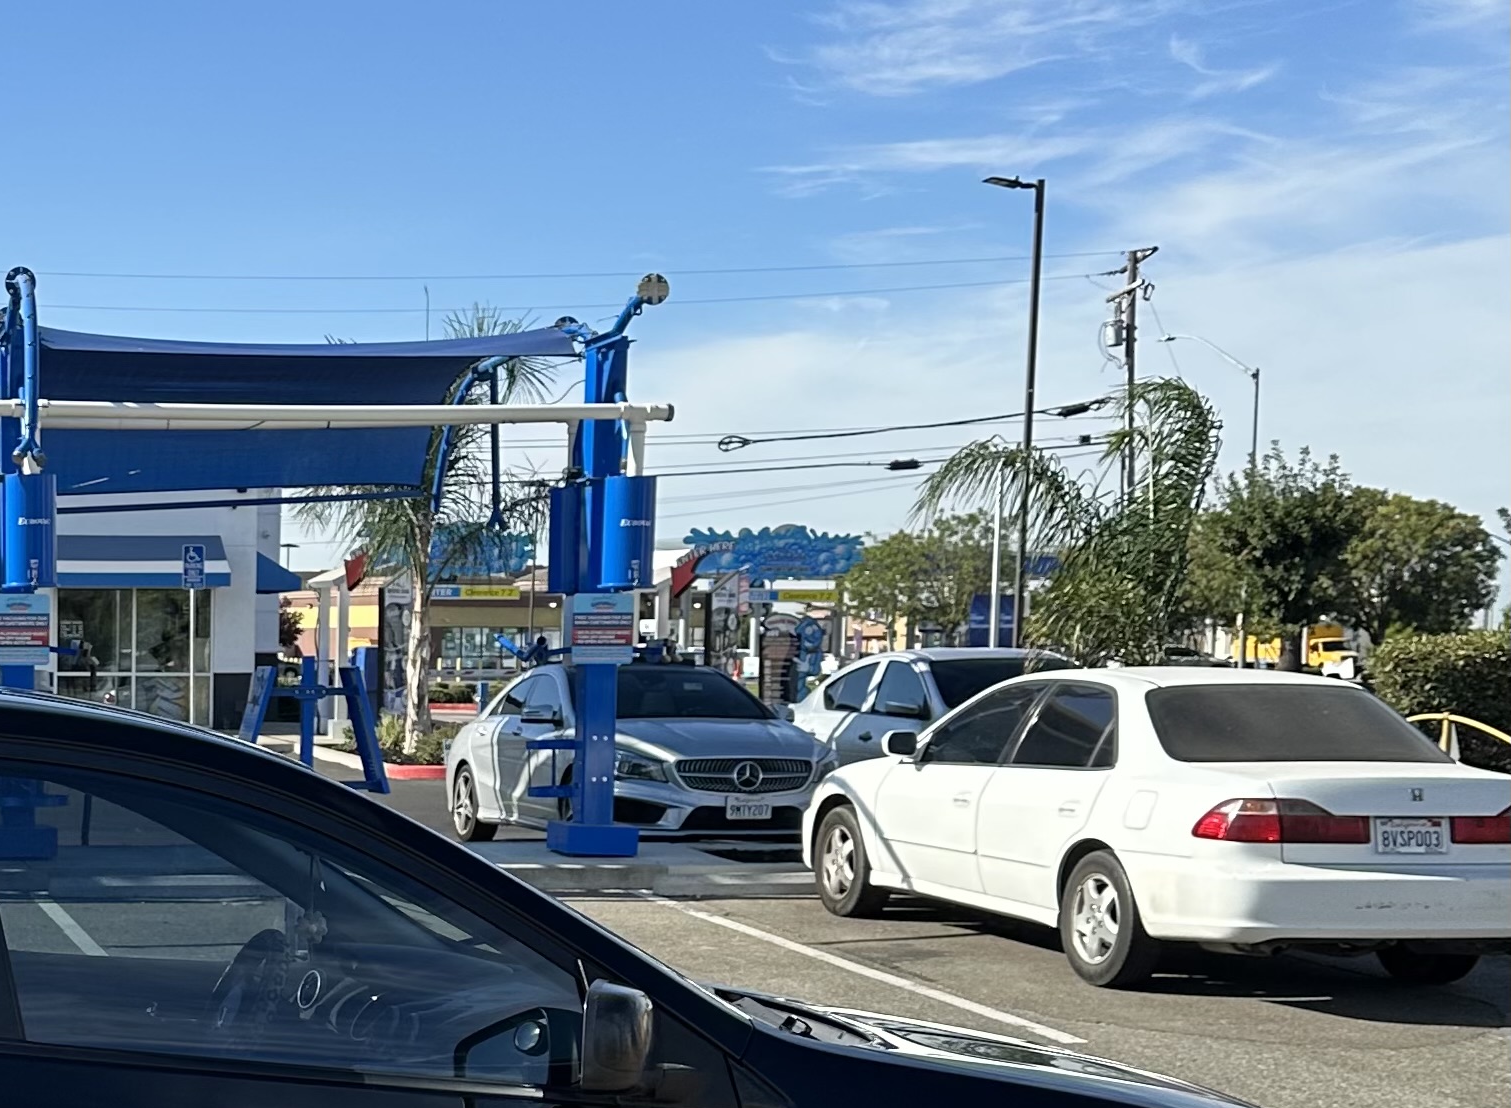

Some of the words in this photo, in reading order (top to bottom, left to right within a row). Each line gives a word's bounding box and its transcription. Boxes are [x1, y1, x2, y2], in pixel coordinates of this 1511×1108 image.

[709, 541, 735, 552] HERE
[729, 804, 770, 817] 9MTY207
[1382, 830, 1441, 848] 8VSP003
